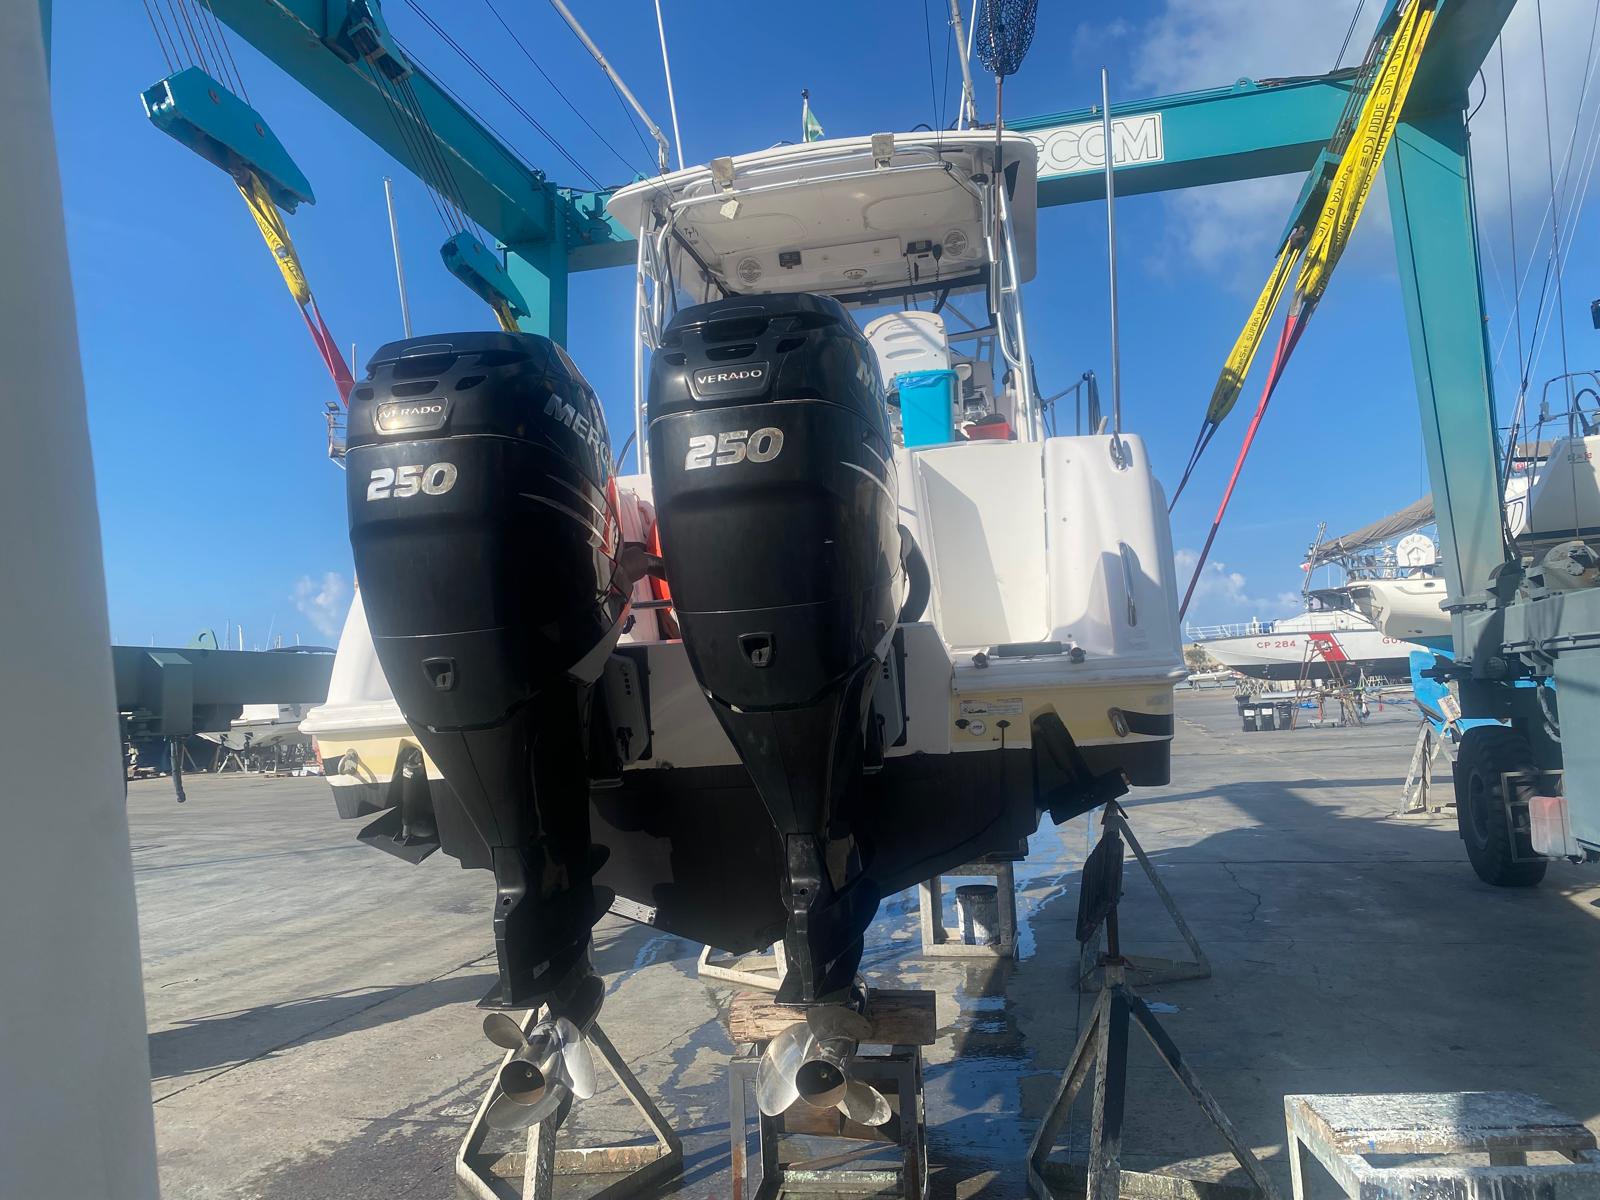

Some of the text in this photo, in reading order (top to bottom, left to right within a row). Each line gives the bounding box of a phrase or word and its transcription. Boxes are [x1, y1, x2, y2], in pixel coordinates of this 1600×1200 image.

[1381, 65, 1398, 95] PLUS
[1368, 103, 1387, 133] 3000
[1362, 136, 1377, 155] KG
[1246, 316, 1261, 342] SUPRA
[1257, 294, 1269, 316] PLUS
[697, 369, 763, 384] VERADO
[380, 405, 443, 419] VERADO
[684, 426, 785, 472] 250
[366, 461, 458, 502] 250
[1256, 640, 1297, 649] CP 284
